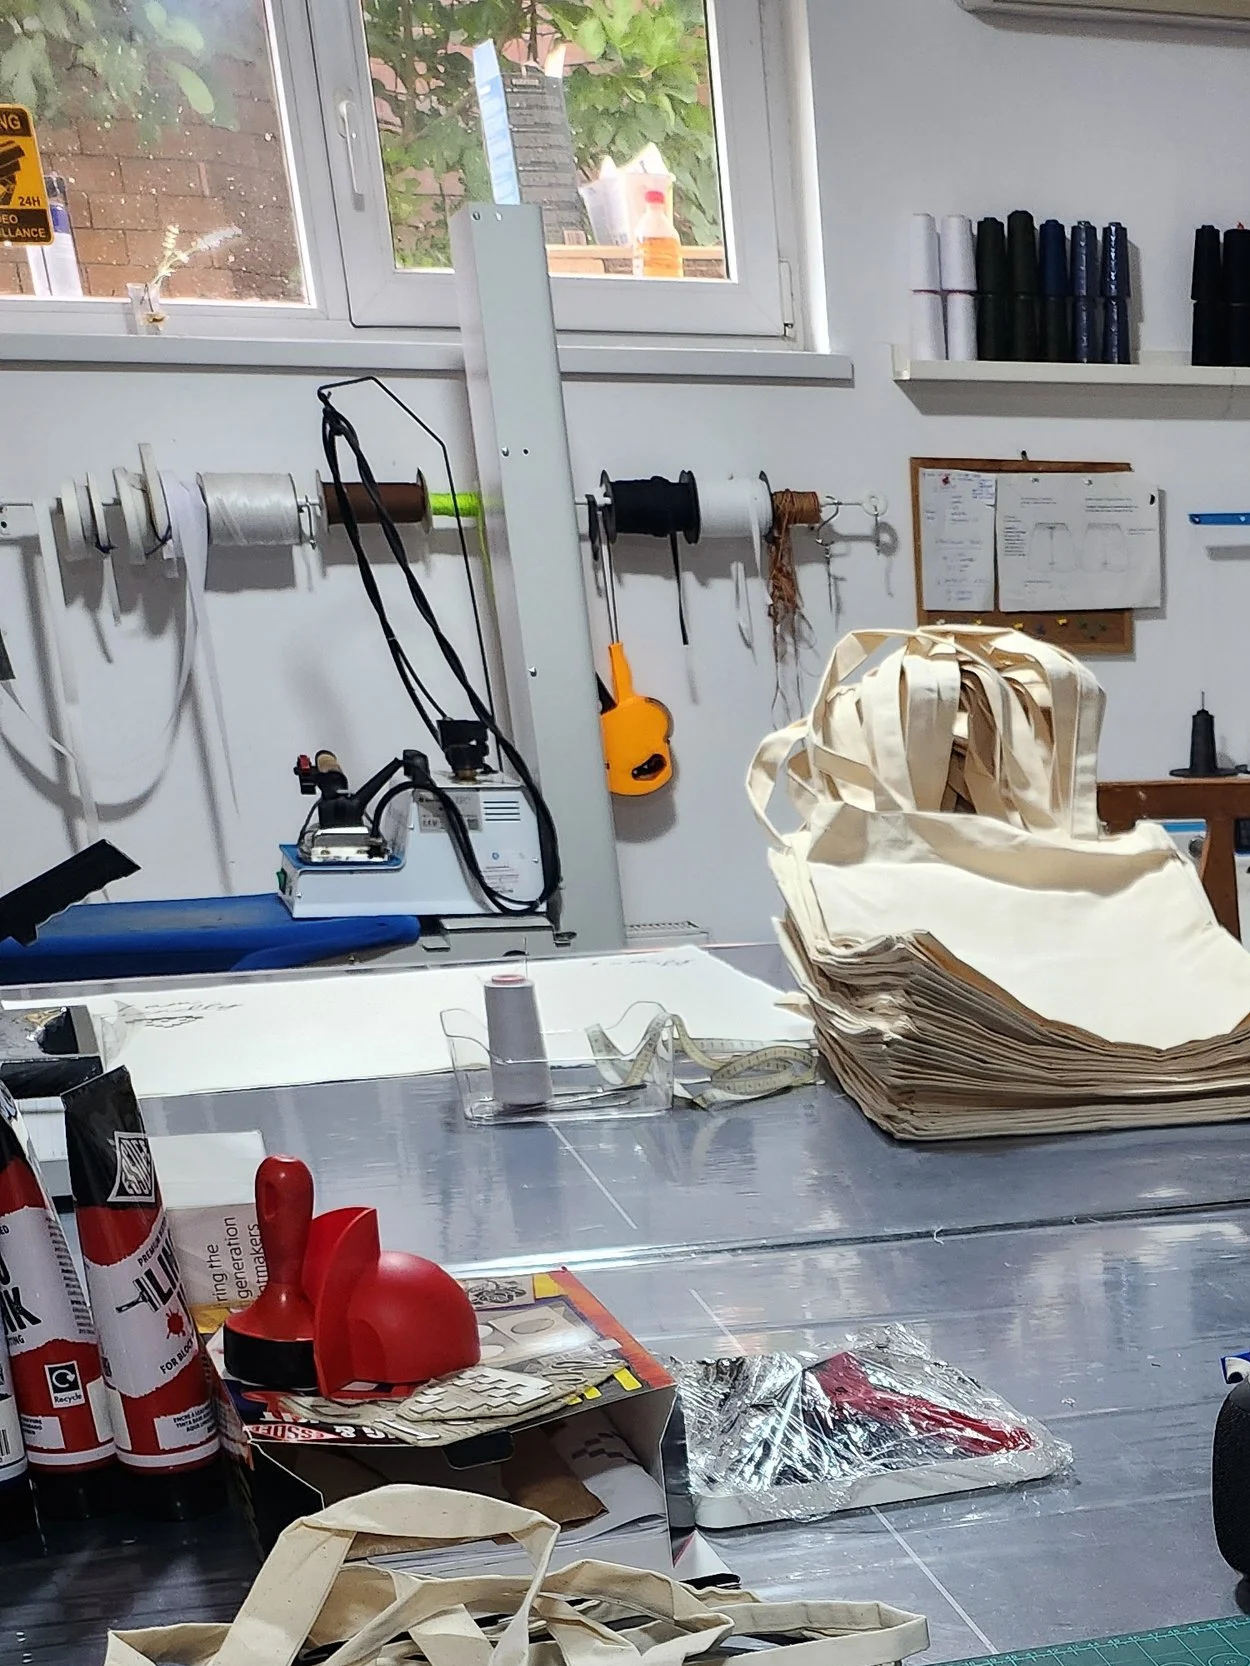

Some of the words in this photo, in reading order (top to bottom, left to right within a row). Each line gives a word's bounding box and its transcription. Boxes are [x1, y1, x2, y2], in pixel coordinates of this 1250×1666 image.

[18, 195, 41, 207] 24H
[205, 1243, 222, 1269] the
[224, 1216, 253, 1299] generation
[160, 1358, 179, 1374] FOR
[54, 1393, 82, 1404] Recycle
